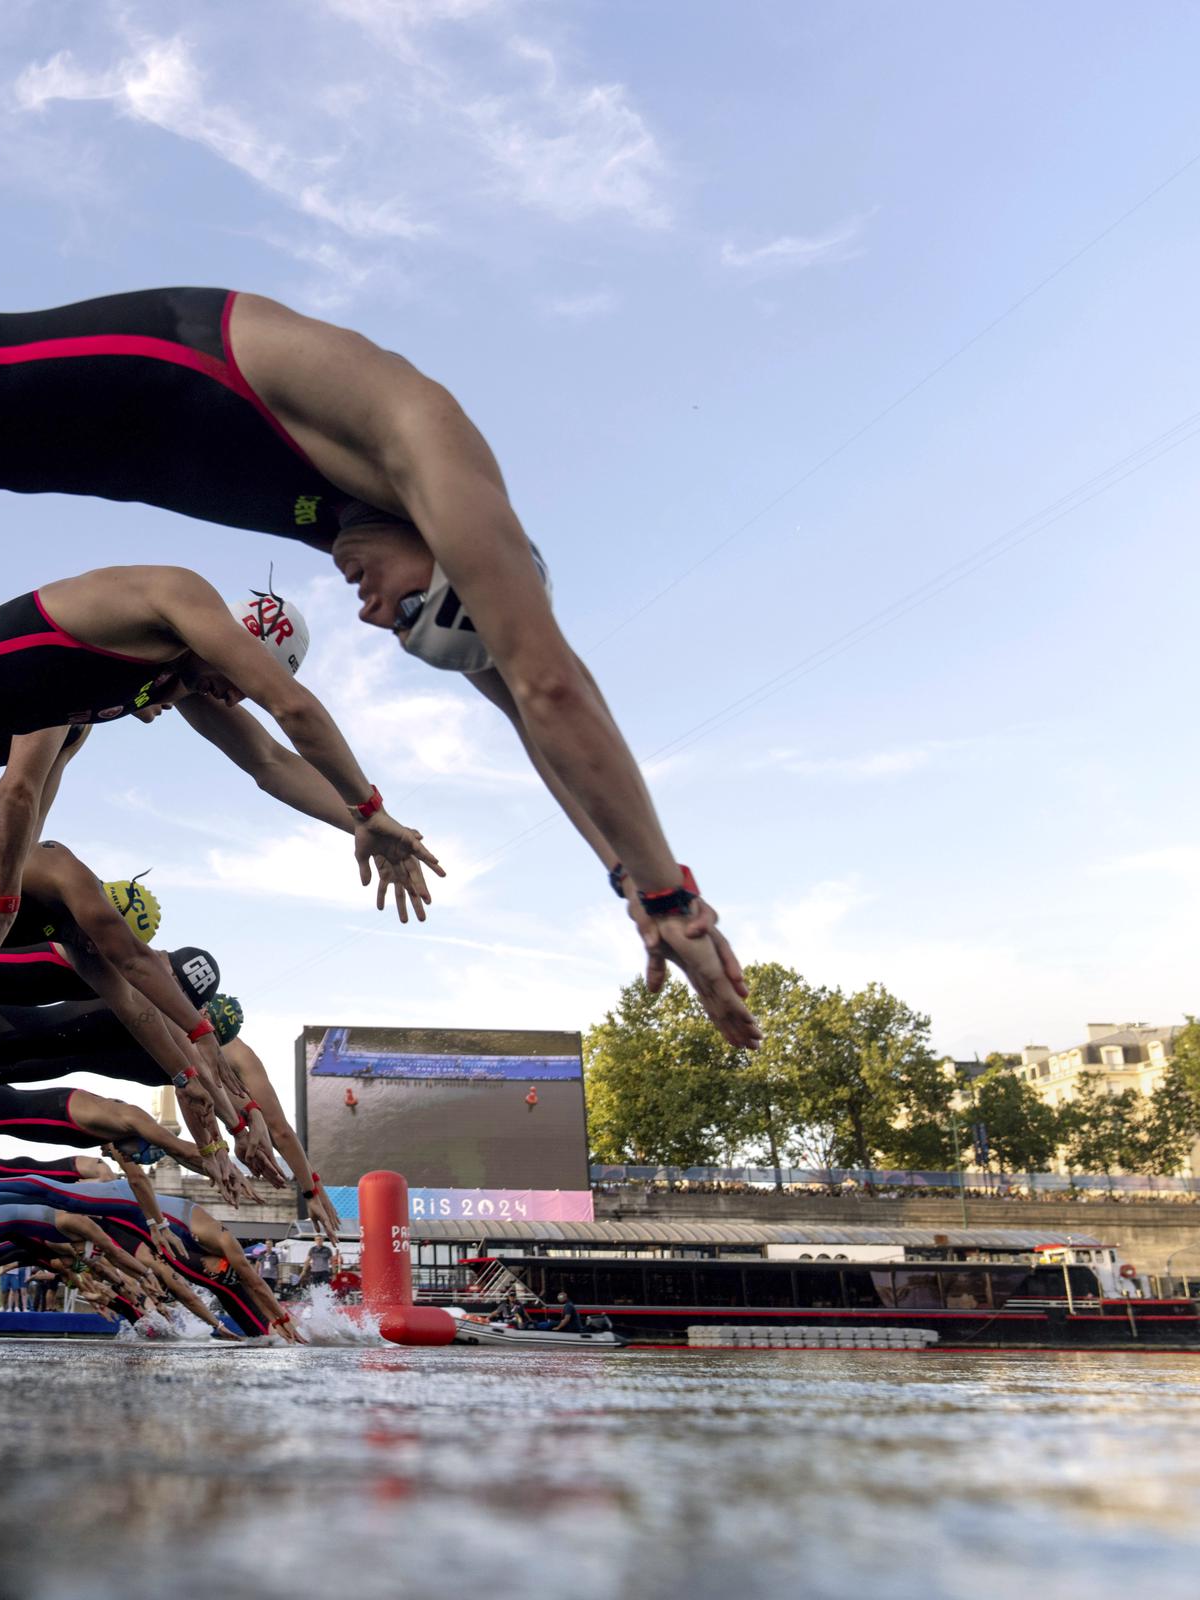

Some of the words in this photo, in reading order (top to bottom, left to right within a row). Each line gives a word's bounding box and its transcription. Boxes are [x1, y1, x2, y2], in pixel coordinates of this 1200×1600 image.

[248, 597, 294, 646] TUR
[110, 886, 123, 912] FARIN
[125, 887, 150, 930] ECU
[182, 955, 217, 995] GER
[413, 1198, 451, 1215] RiS
[461, 1199, 527, 1217] 2024
